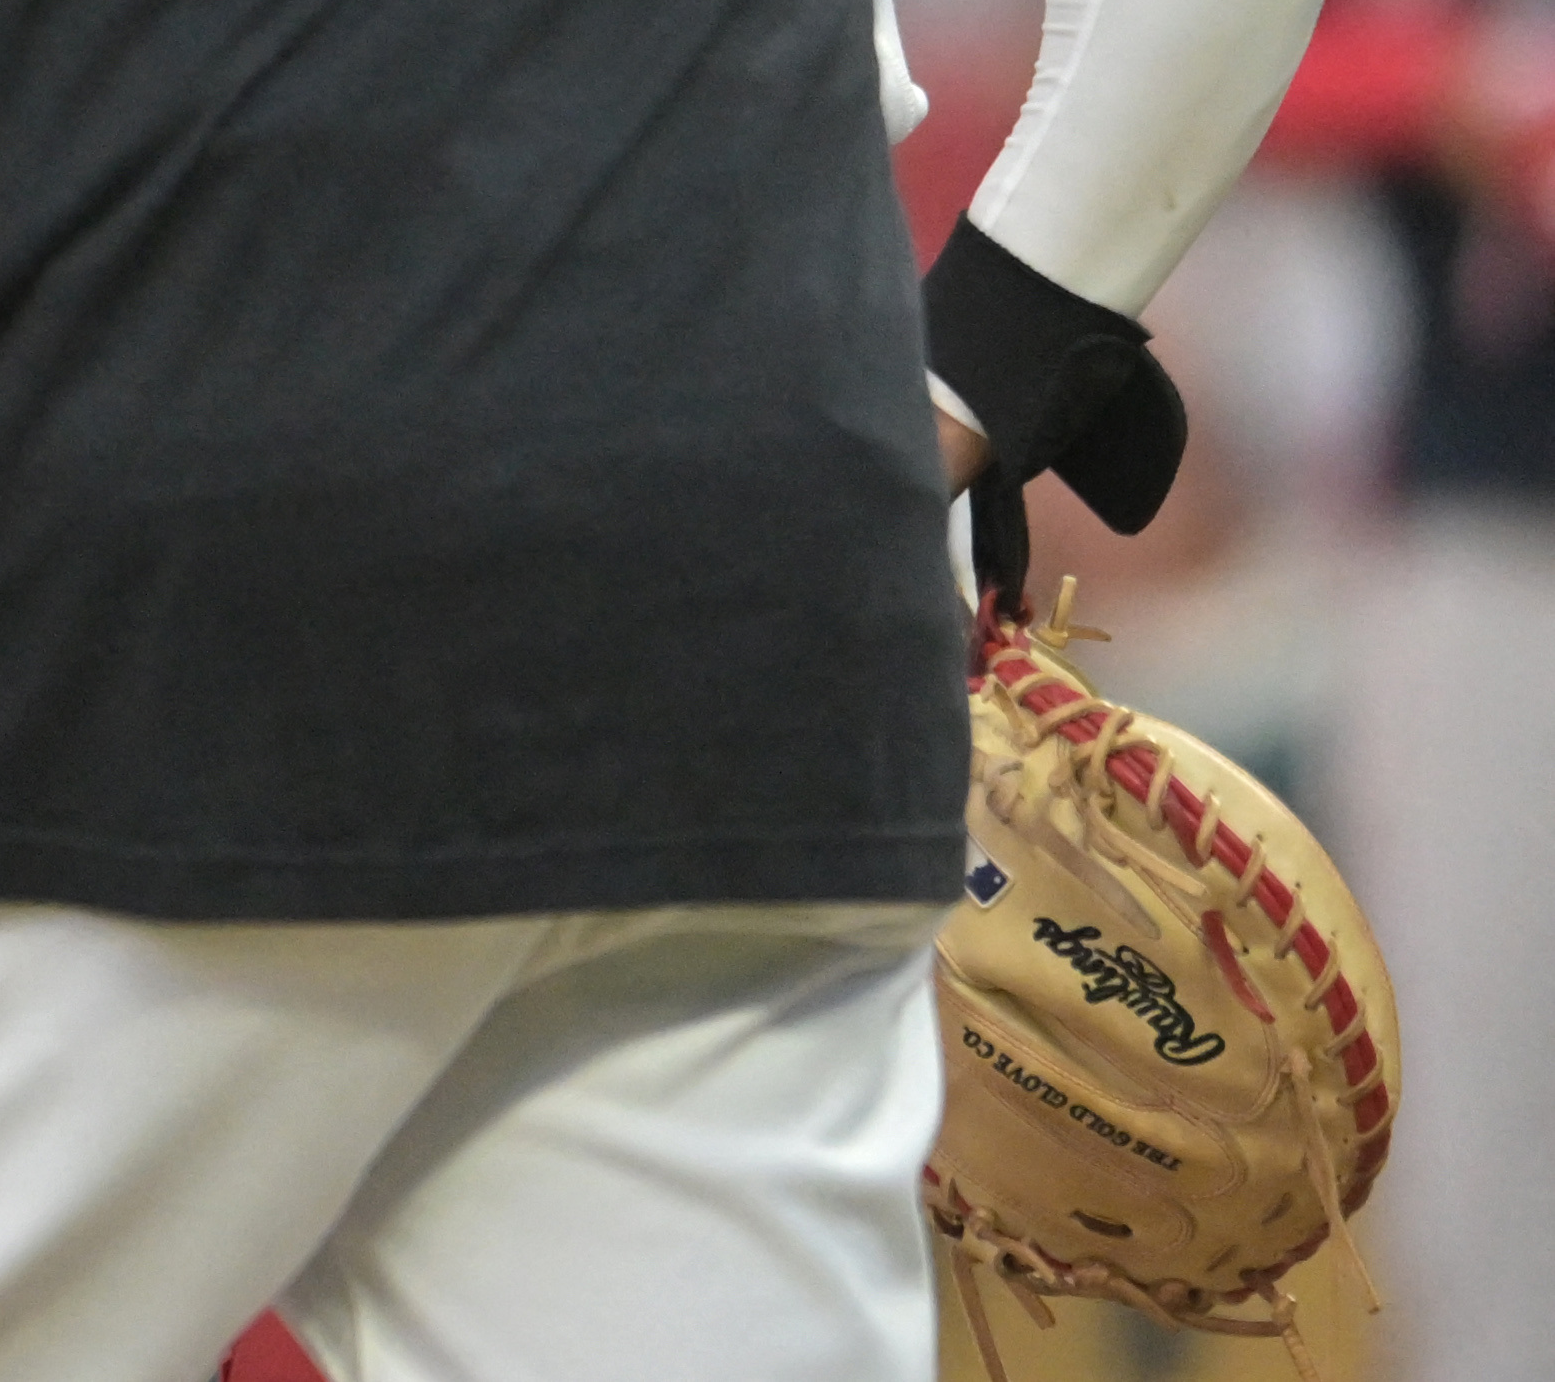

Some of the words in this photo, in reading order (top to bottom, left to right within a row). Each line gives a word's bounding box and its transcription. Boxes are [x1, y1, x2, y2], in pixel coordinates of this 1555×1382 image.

[1033, 917, 1226, 1067] Rawlings
[992, 1052, 1069, 1110] GLOVE
[1069, 1103, 1132, 1147] GOLD
[1131, 1140, 1183, 1172] THE
